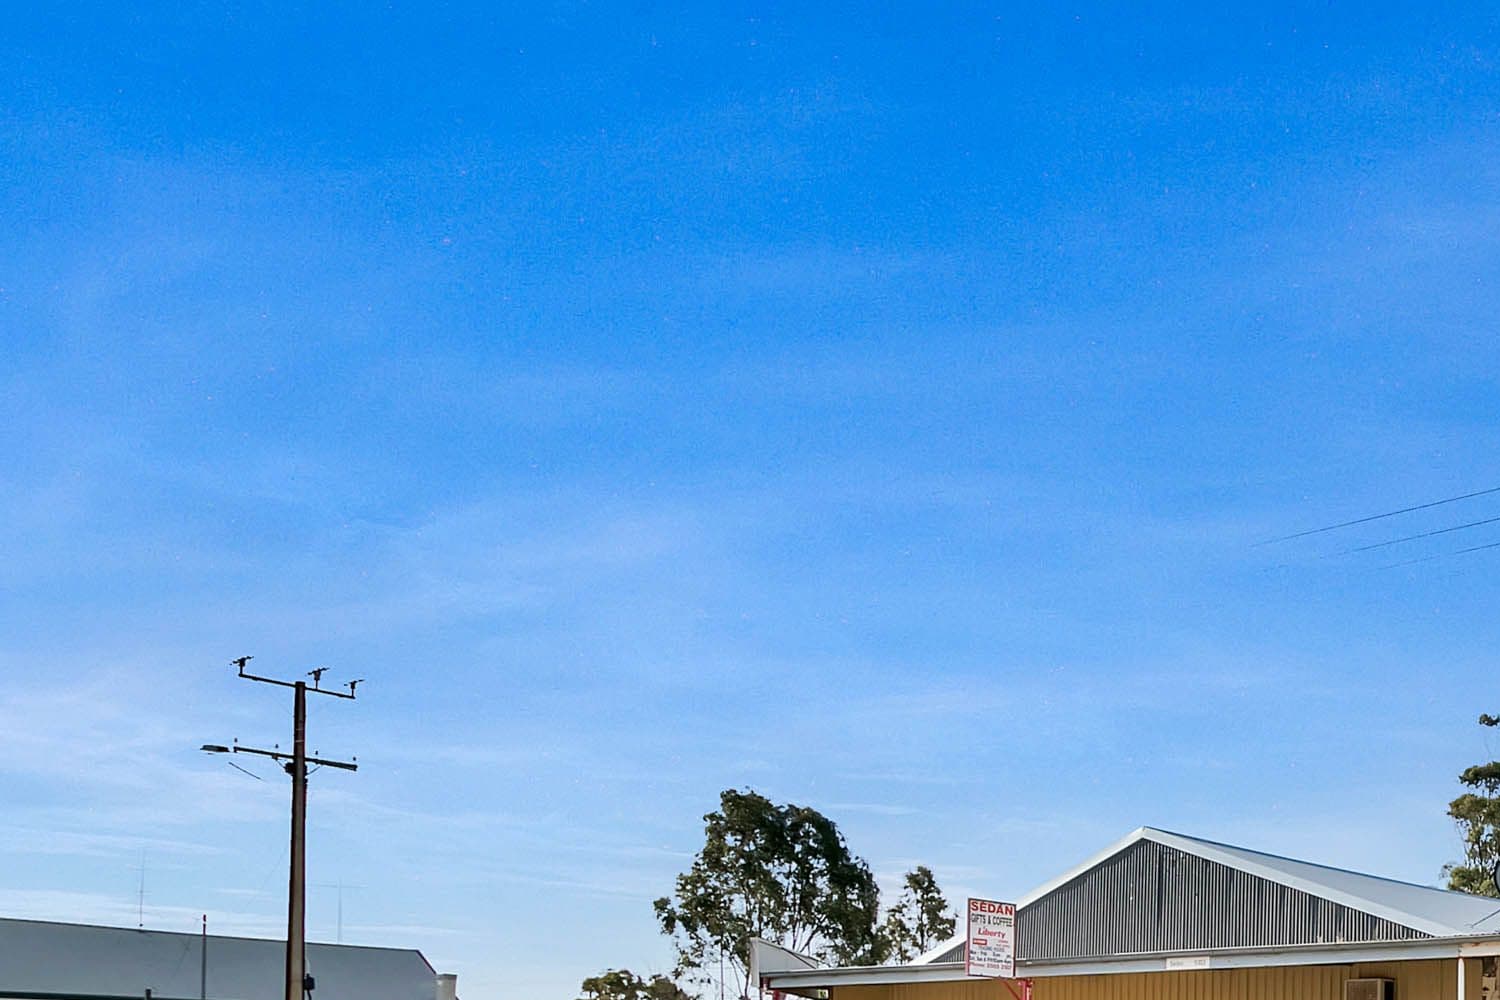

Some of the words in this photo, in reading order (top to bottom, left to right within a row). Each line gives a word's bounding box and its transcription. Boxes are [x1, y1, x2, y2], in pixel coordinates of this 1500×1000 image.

[971, 901, 1013, 916] SEDAN
[993, 916, 1013, 927] COFFEE
[978, 926, 1006, 939] Liberty
